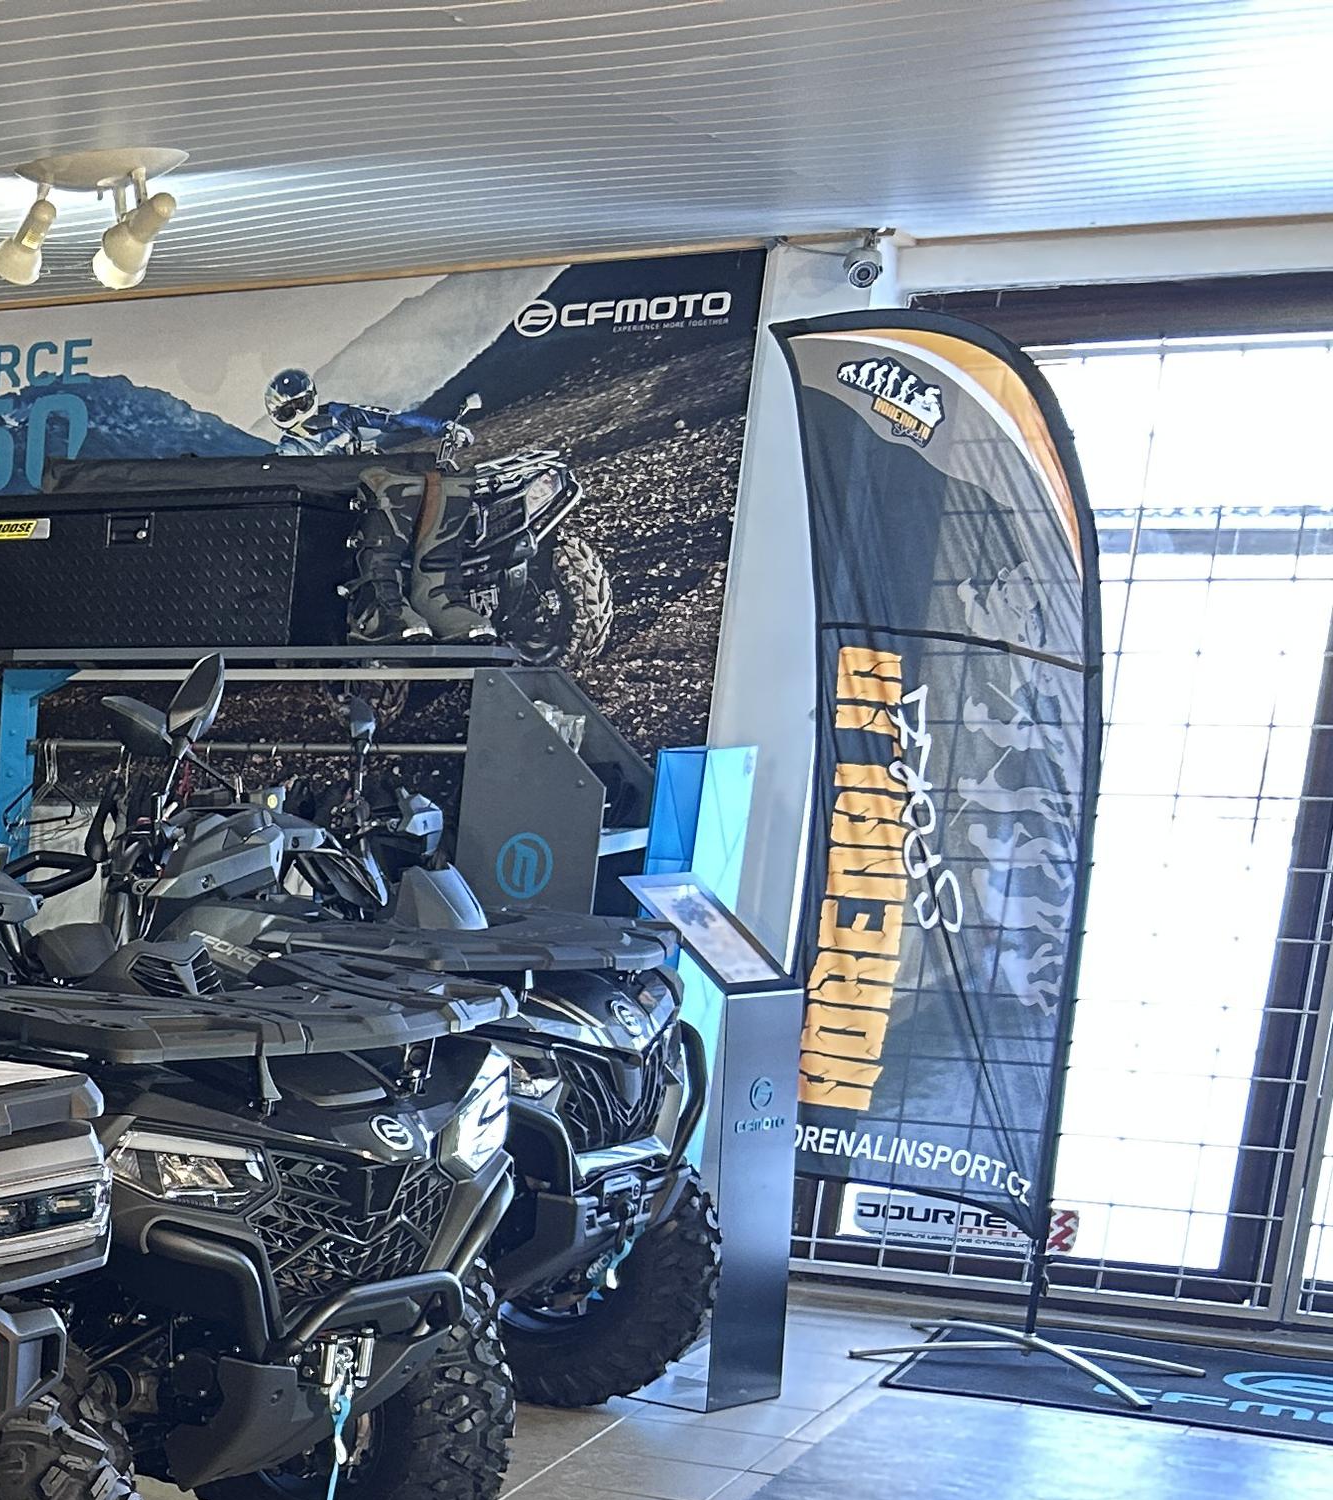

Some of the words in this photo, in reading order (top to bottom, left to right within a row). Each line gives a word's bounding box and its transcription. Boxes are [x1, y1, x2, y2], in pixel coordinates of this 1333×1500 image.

[560, 291, 732, 328] CFMOTO
[612, 322, 661, 334] EXPERIENCE
[663, 320, 686, 330] MORE
[688, 317, 730, 328] TOGETHER
[190, 929, 263, 968] FORC
[794, 1122, 1031, 1207] DRENALINSPORT.CZ
[857, 1201, 1008, 1229] JOURNE
